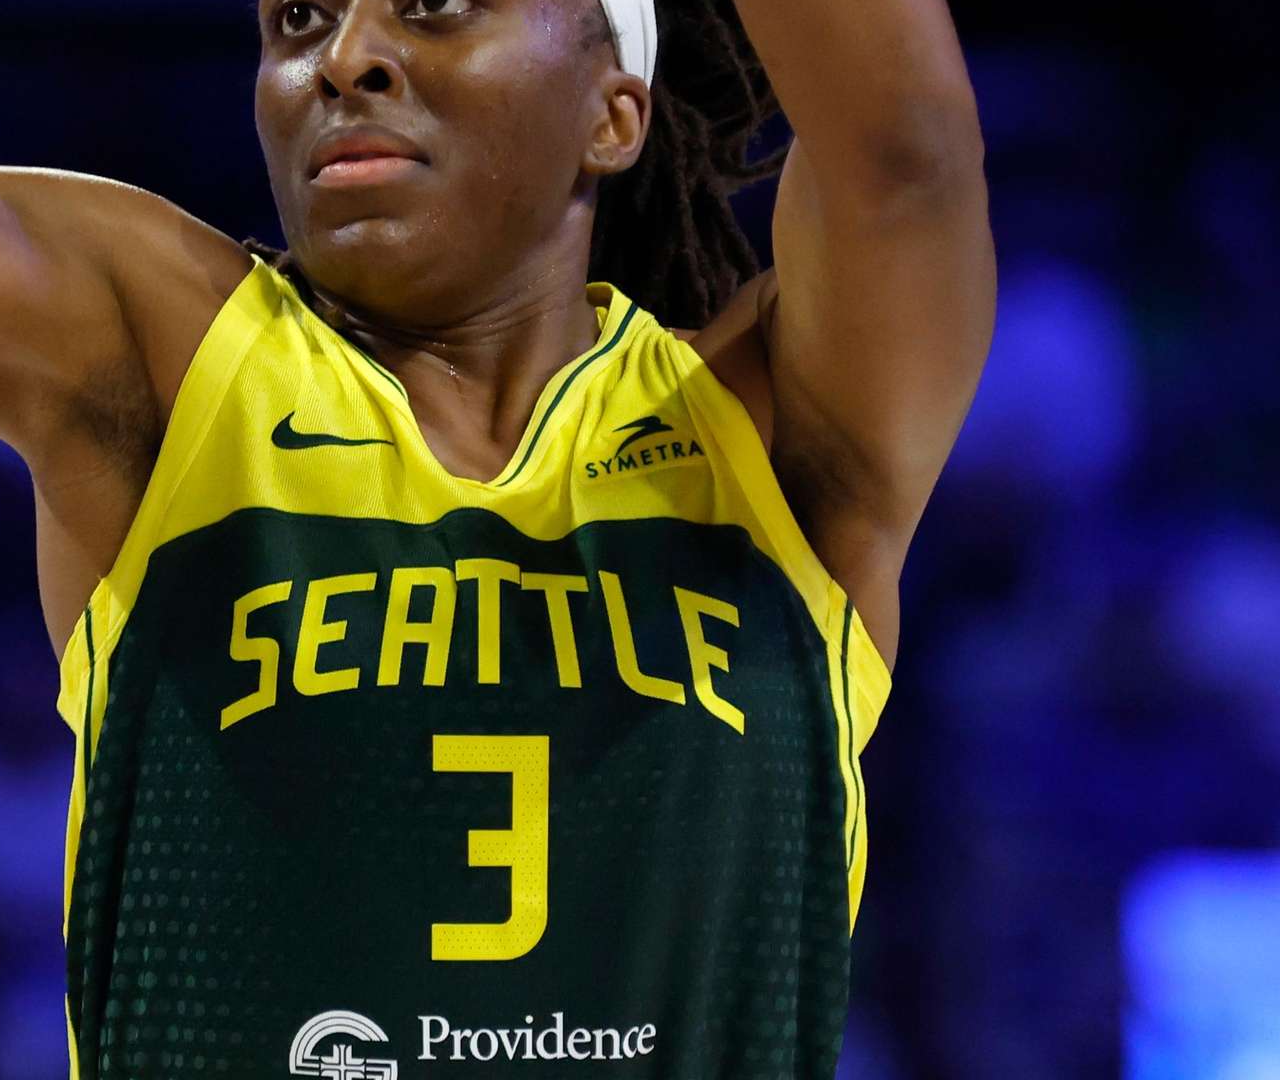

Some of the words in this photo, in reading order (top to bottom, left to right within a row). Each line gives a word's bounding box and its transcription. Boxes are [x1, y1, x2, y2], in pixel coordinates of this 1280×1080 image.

[584, 439, 705, 479] SYMETRA
[220, 557, 745, 736] SEATTLE
[431, 734, 550, 961] 3
[417, 1011, 657, 1061] Providence
